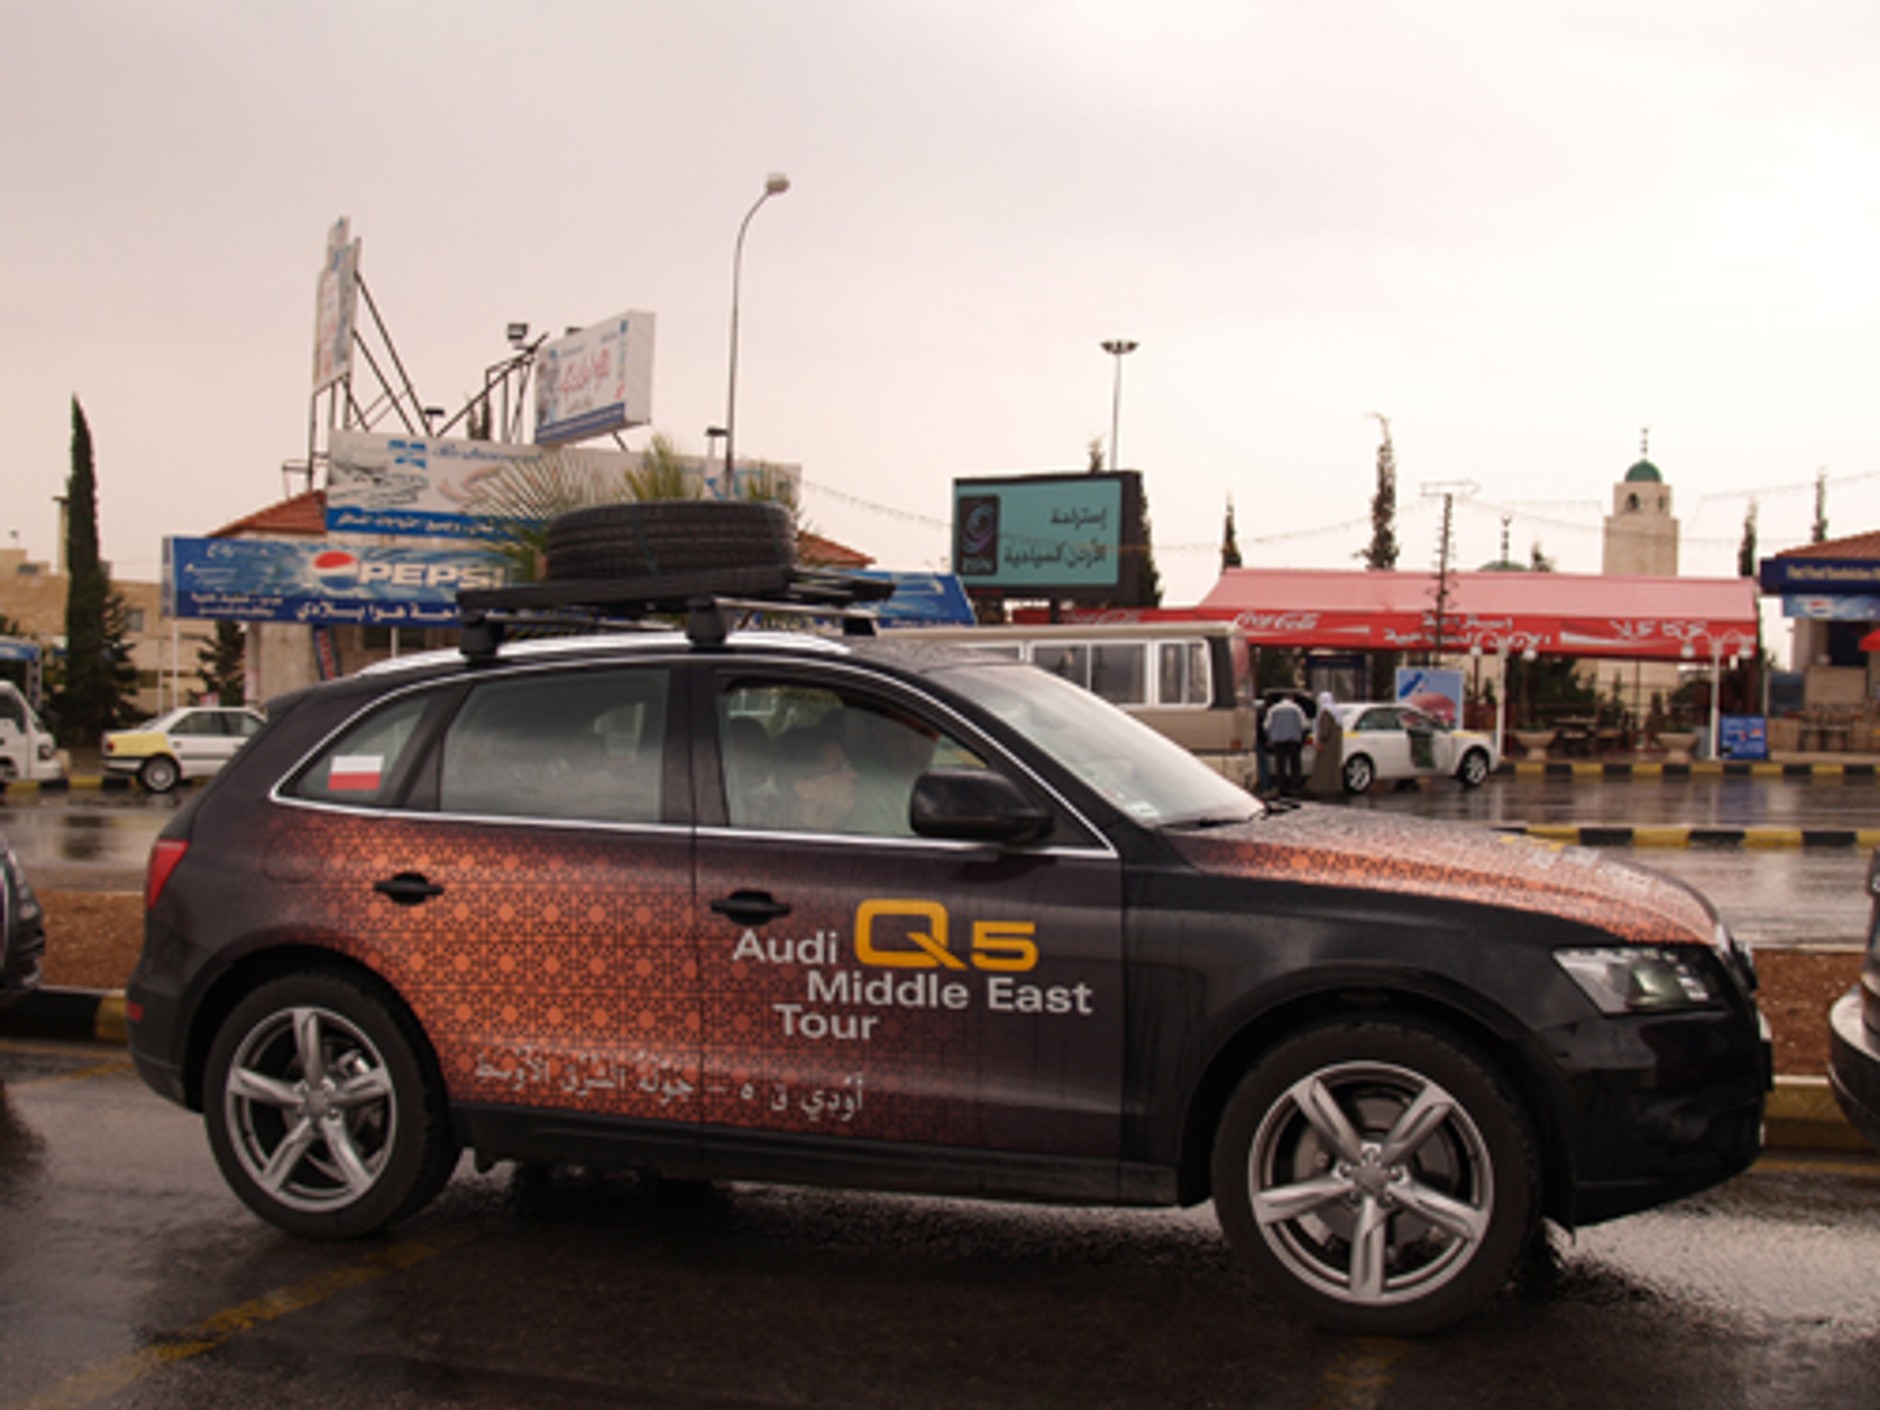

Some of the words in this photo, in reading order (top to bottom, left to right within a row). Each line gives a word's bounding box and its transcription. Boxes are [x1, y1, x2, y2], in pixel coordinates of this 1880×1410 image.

[359, 562, 506, 589] PEPSI
[1234, 610, 1320, 630] Coca-Cola
[732, 929, 838, 966] Audi
[854, 898, 1040, 972] Q5
[806, 969, 969, 1010] Middle
[985, 976, 1093, 1016] East
[772, 1003, 879, 1041] Tour
